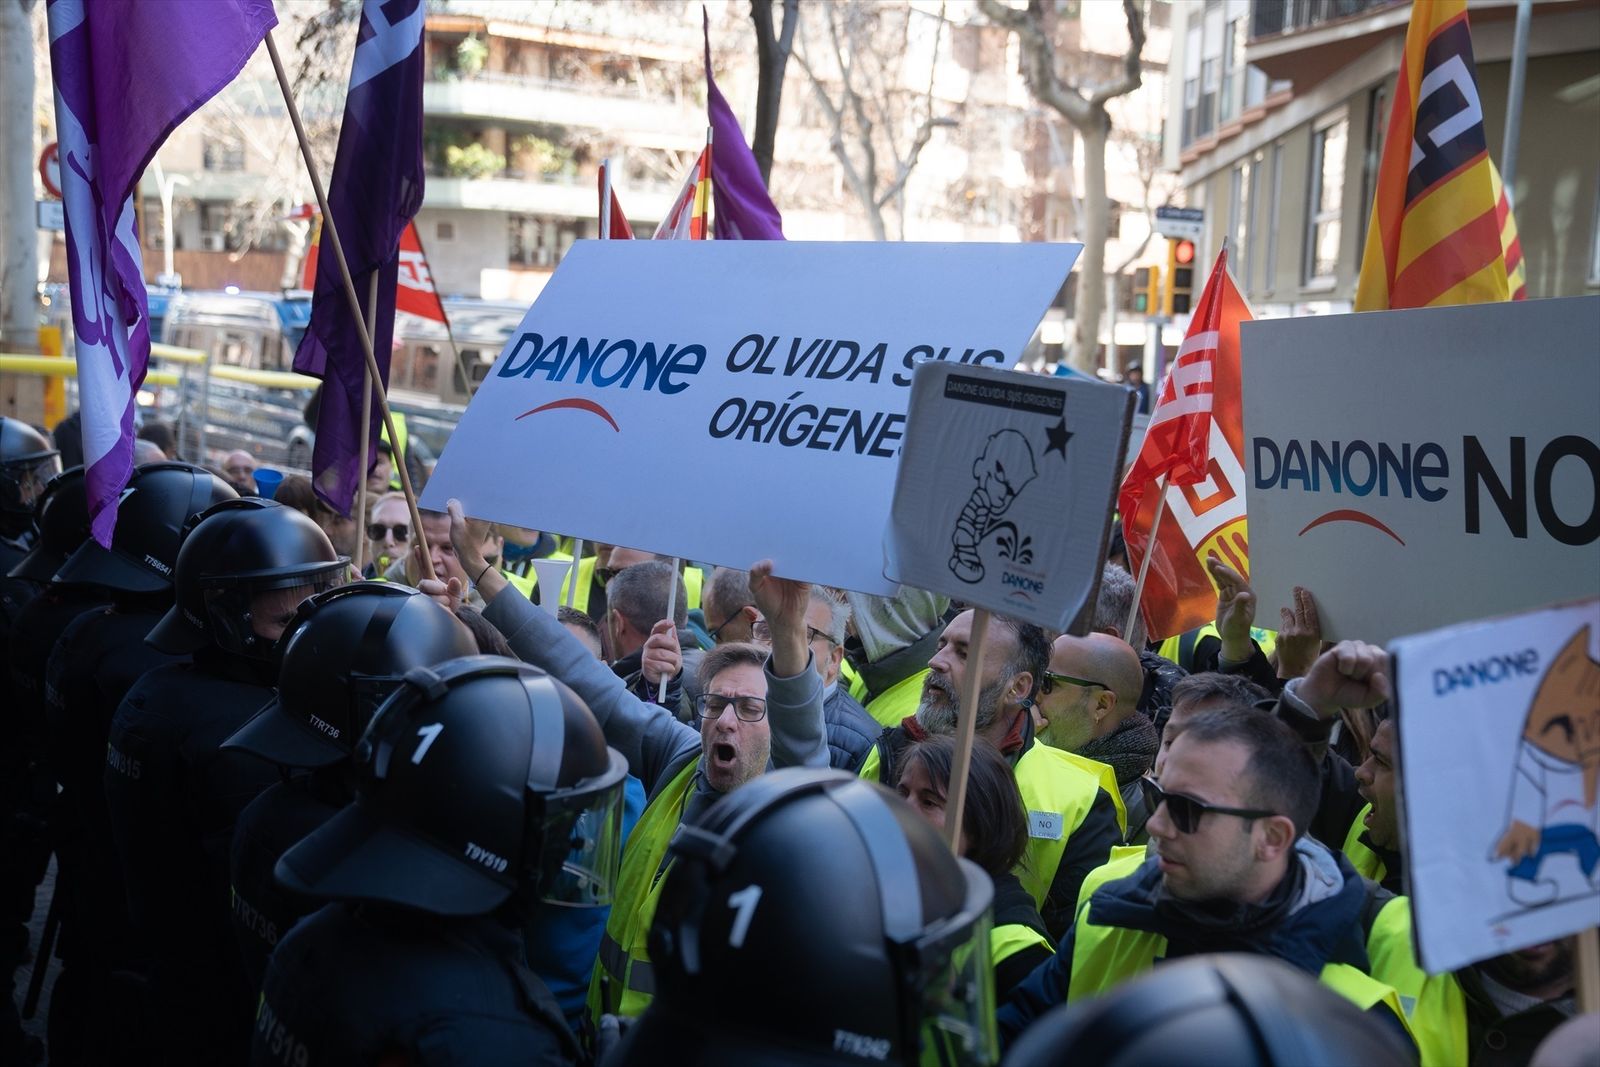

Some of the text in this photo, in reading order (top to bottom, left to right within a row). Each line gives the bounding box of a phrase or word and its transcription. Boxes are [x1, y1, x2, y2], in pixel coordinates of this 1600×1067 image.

[726, 333, 888, 384] OLVIDA
[709, 391, 905, 458] ORÍGENE
[1463, 435, 1600, 546] NO
[310, 713, 340, 738] T7R736
[411, 722, 444, 765] 1
[1038, 820, 1052, 829] NO
[728, 884, 763, 948] 1
